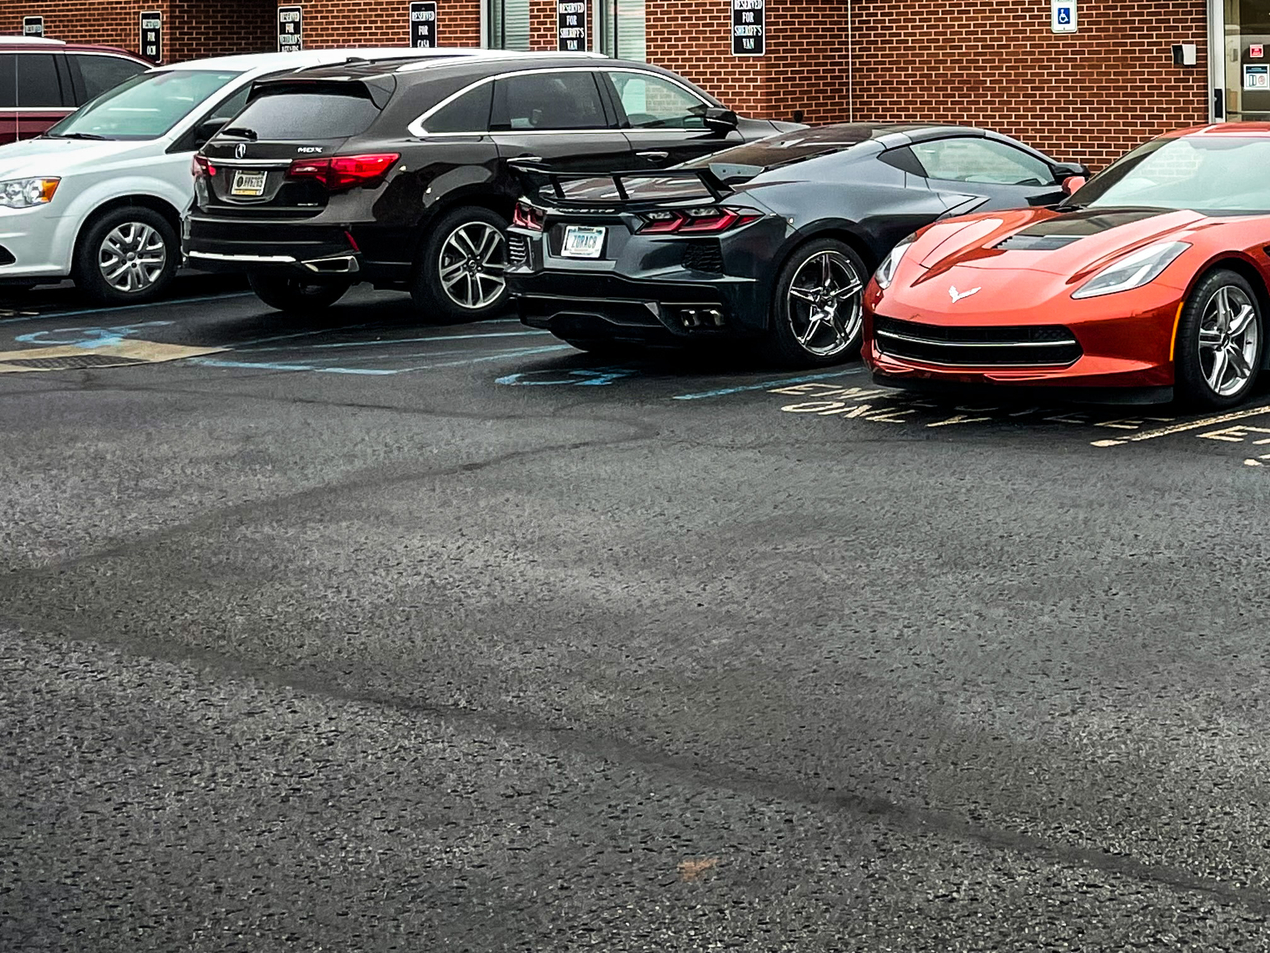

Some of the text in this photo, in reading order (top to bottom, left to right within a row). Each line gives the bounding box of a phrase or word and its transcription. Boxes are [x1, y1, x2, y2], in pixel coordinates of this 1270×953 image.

[559, 2, 584, 14] RESERVED
[566, 15, 577, 26] FOR
[742, 11, 755, 23] FOR
[285, 23, 295, 33] FOR
[418, 25, 429, 36] FOR
[742, 38, 755, 49] VAN
[780, 401, 992, 427] ONLY
